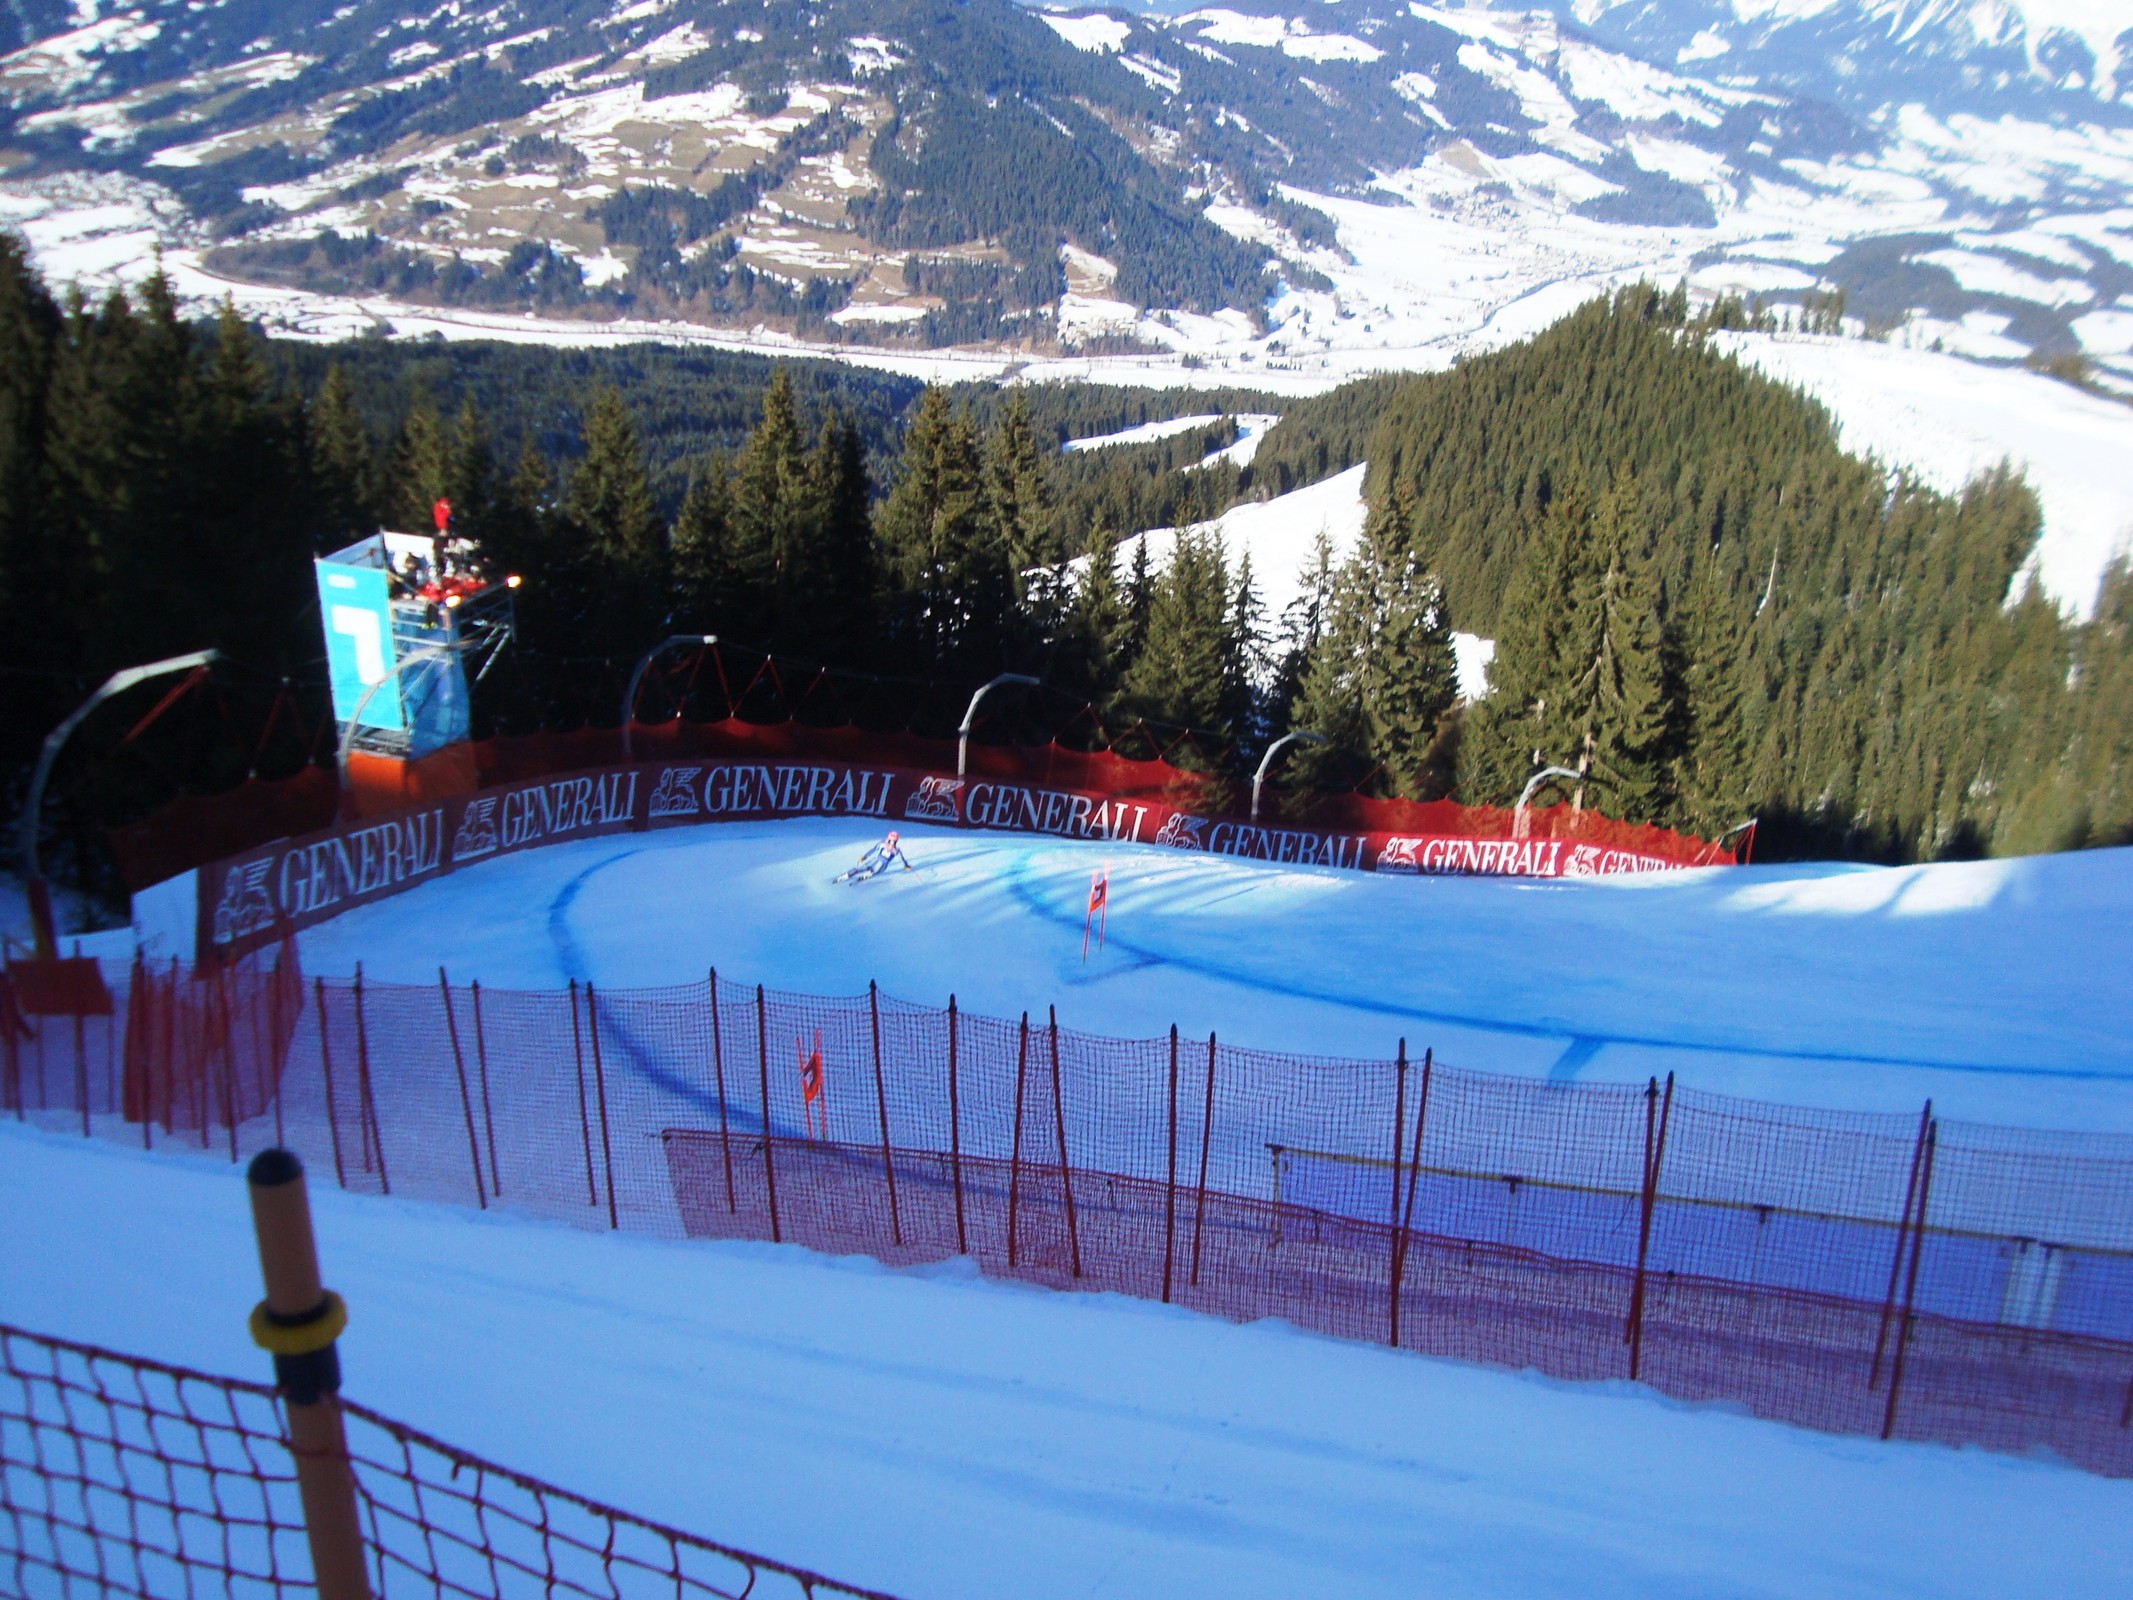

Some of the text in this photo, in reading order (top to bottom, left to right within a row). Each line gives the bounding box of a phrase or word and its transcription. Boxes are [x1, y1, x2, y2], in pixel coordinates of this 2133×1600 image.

[501, 770, 638, 849] GENERALI
[704, 766, 896, 816] GENERALI
[965, 782, 1148, 843] GENERALI
[279, 808, 444, 920] GENERALI
[1208, 822, 1367, 870] GENERALI
[1422, 839, 1562, 876] GENERALI
